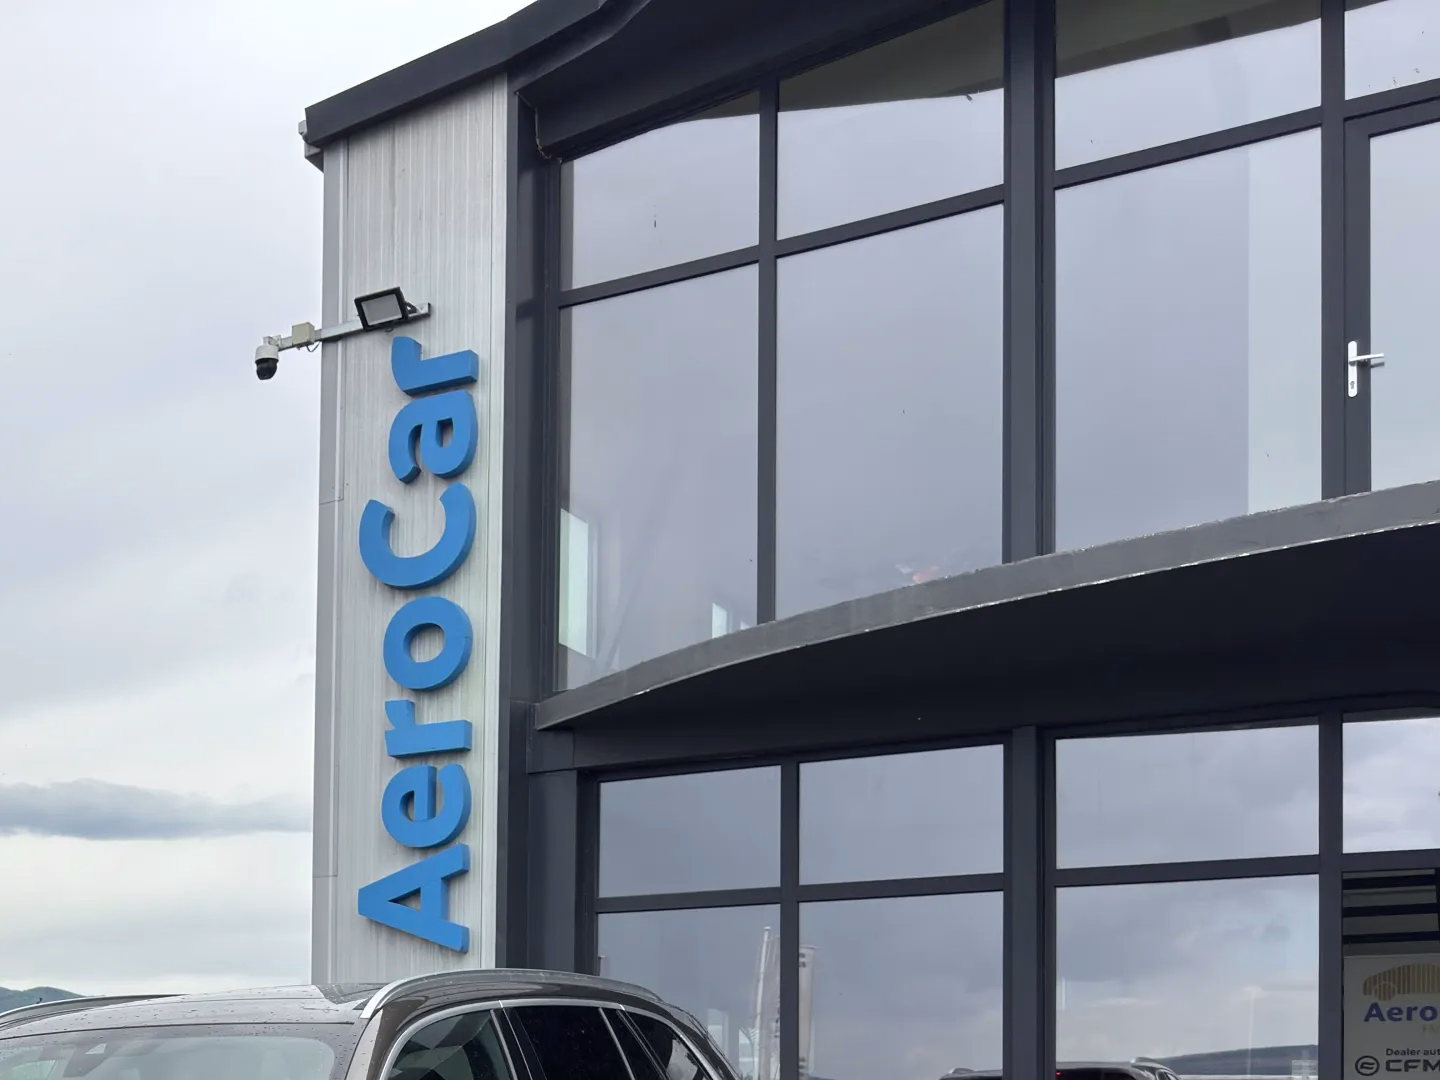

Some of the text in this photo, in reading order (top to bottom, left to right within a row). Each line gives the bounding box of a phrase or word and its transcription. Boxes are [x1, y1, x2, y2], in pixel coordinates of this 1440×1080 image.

[357, 336, 479, 954] AeroCar
[1363, 1001, 1438, 1022] Aero
[1385, 1048, 1421, 1056] Dealer
